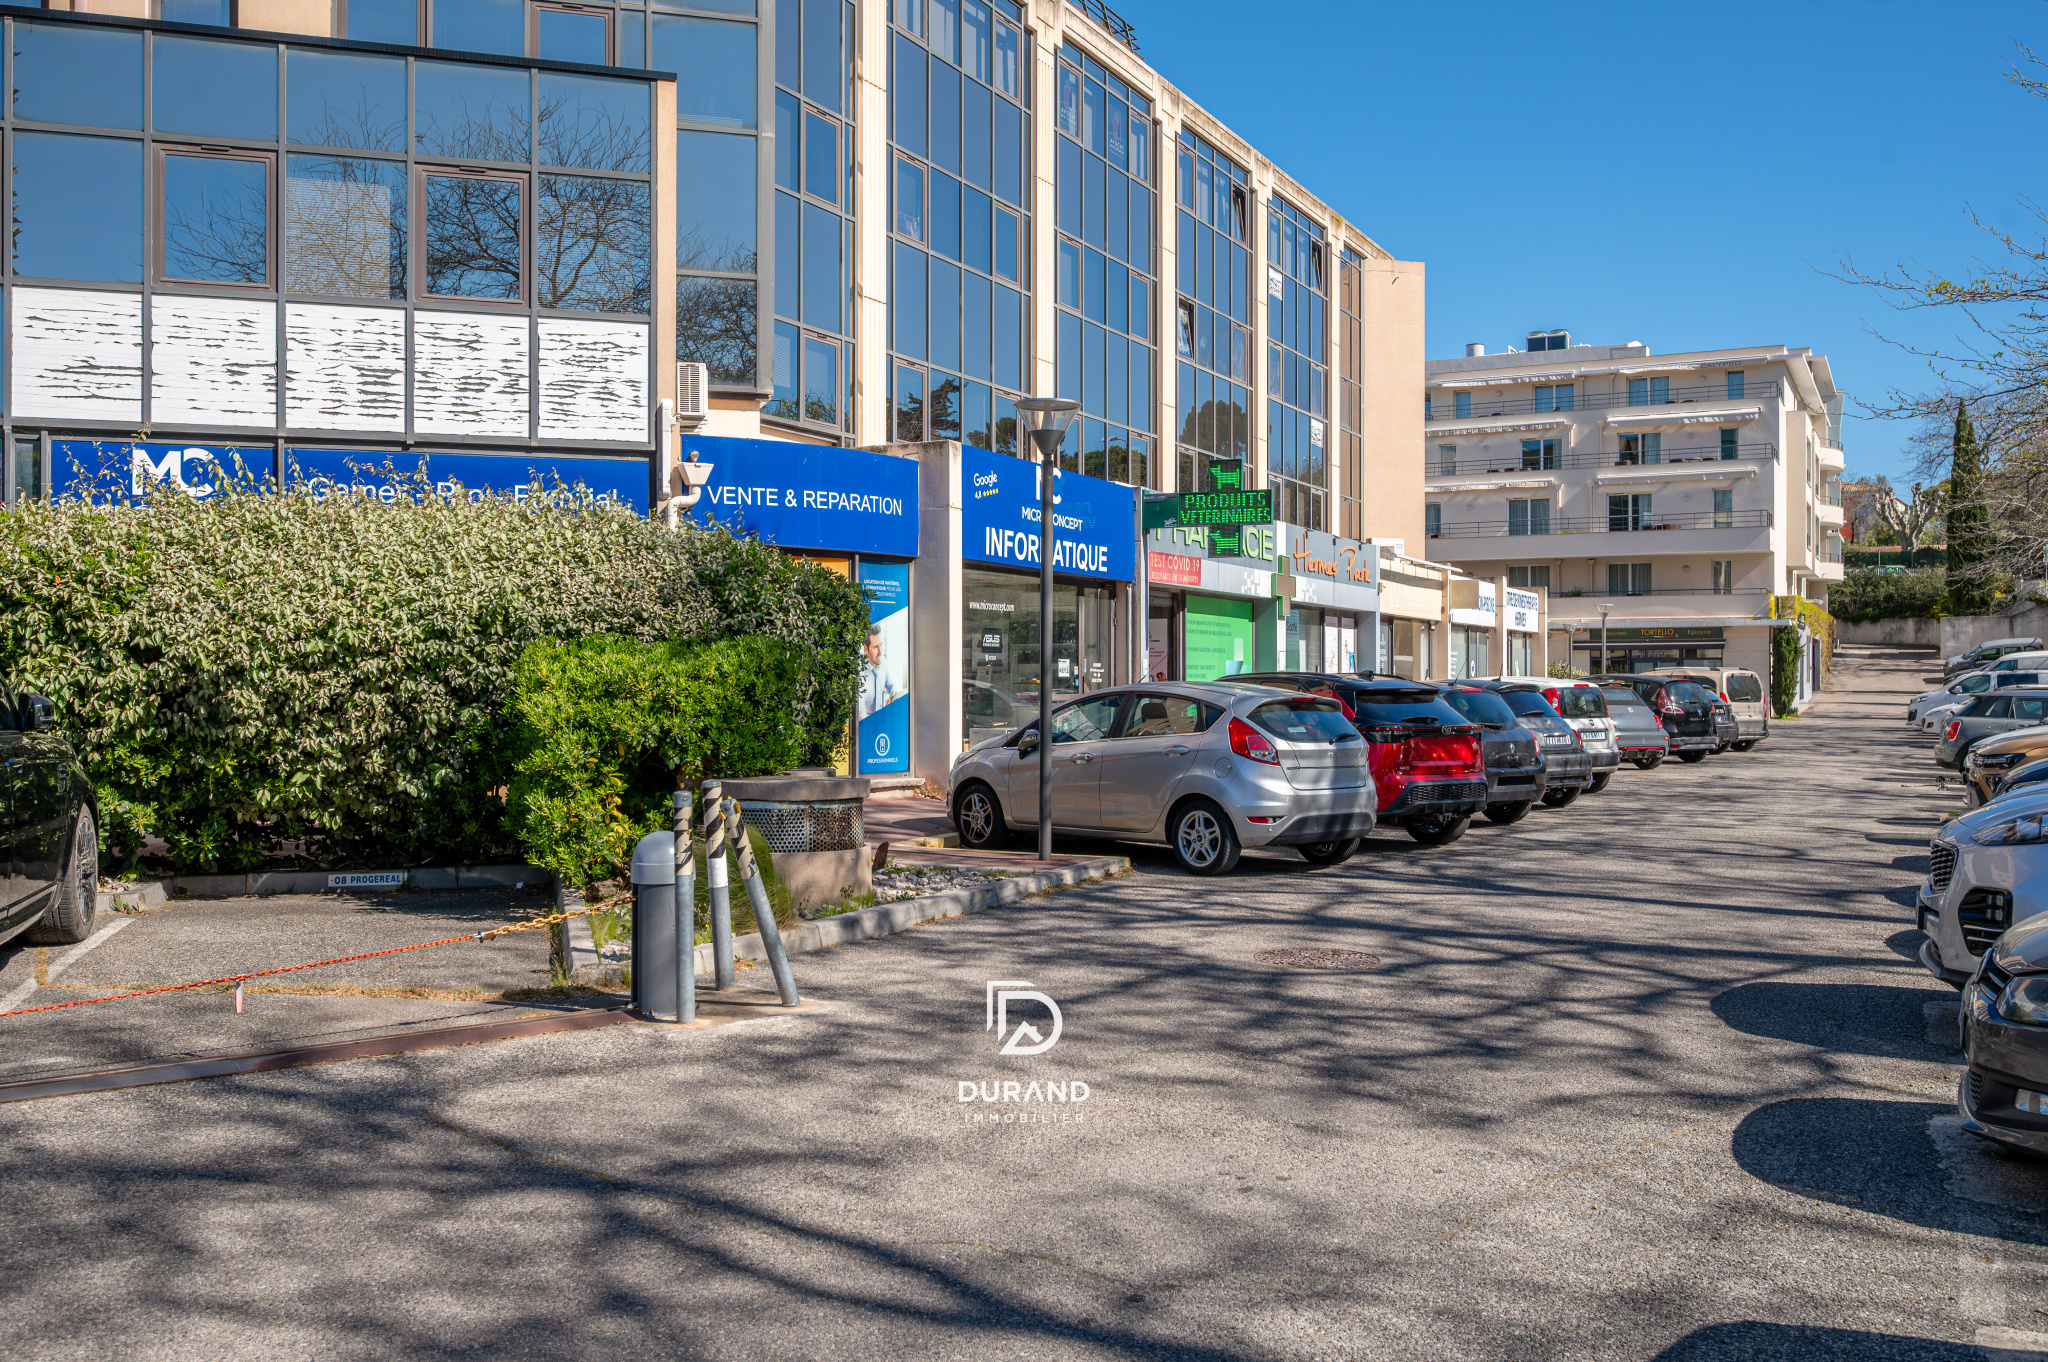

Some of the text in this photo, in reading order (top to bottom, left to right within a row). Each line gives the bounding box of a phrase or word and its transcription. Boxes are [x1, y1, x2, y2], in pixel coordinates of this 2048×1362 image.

[973, 471, 998, 487] Google
[514, 485, 618, 511] Famiial
[707, 486, 902, 516] VENTE & REPARATION
[1184, 492, 1266, 509] PRODUITS
[1022, 507, 1083, 532] MICRONCEPT
[985, 526, 1108, 573] INFORATIQUE
[1293, 532, 1372, 583] Hermes Park
[1150, 553, 1200, 572] TEST COVID 19
[982, 634, 1001, 643] ASUS
[1641, 628, 1674, 636] TORTELLO
[334, 875, 401, 885] 08 PROGEREAL
